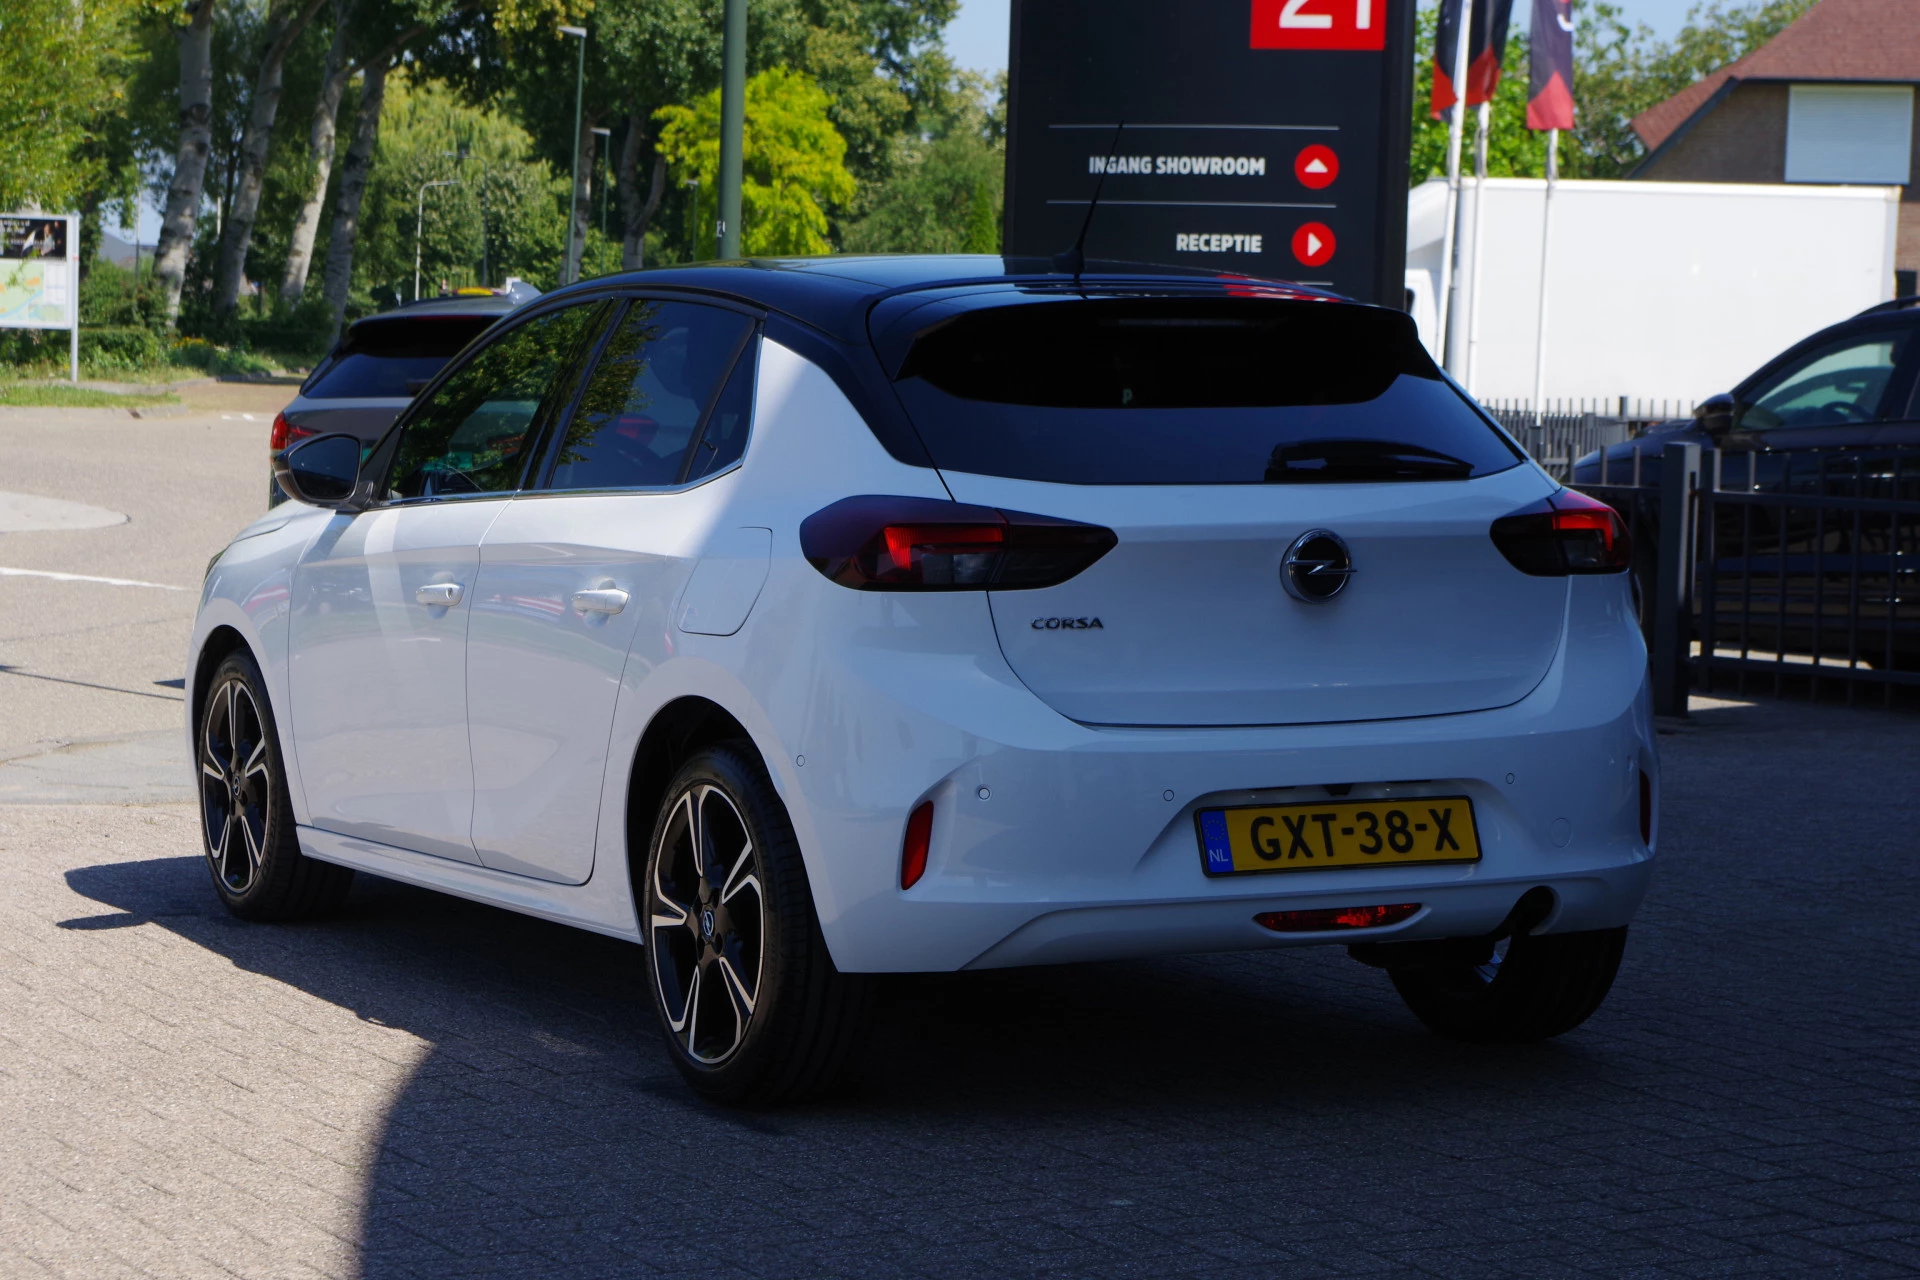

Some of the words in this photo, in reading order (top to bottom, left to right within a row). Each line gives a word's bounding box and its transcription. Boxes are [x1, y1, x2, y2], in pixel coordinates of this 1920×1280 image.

[1088, 155, 1152, 175] INGANG
[1155, 156, 1266, 176] SHOWROOM
[1175, 233, 1262, 253] RECEPTIE
[1031, 616, 1104, 630] CORSA
[1250, 807, 1460, 862] GXT-38-X
[1208, 849, 1229, 863] NL
